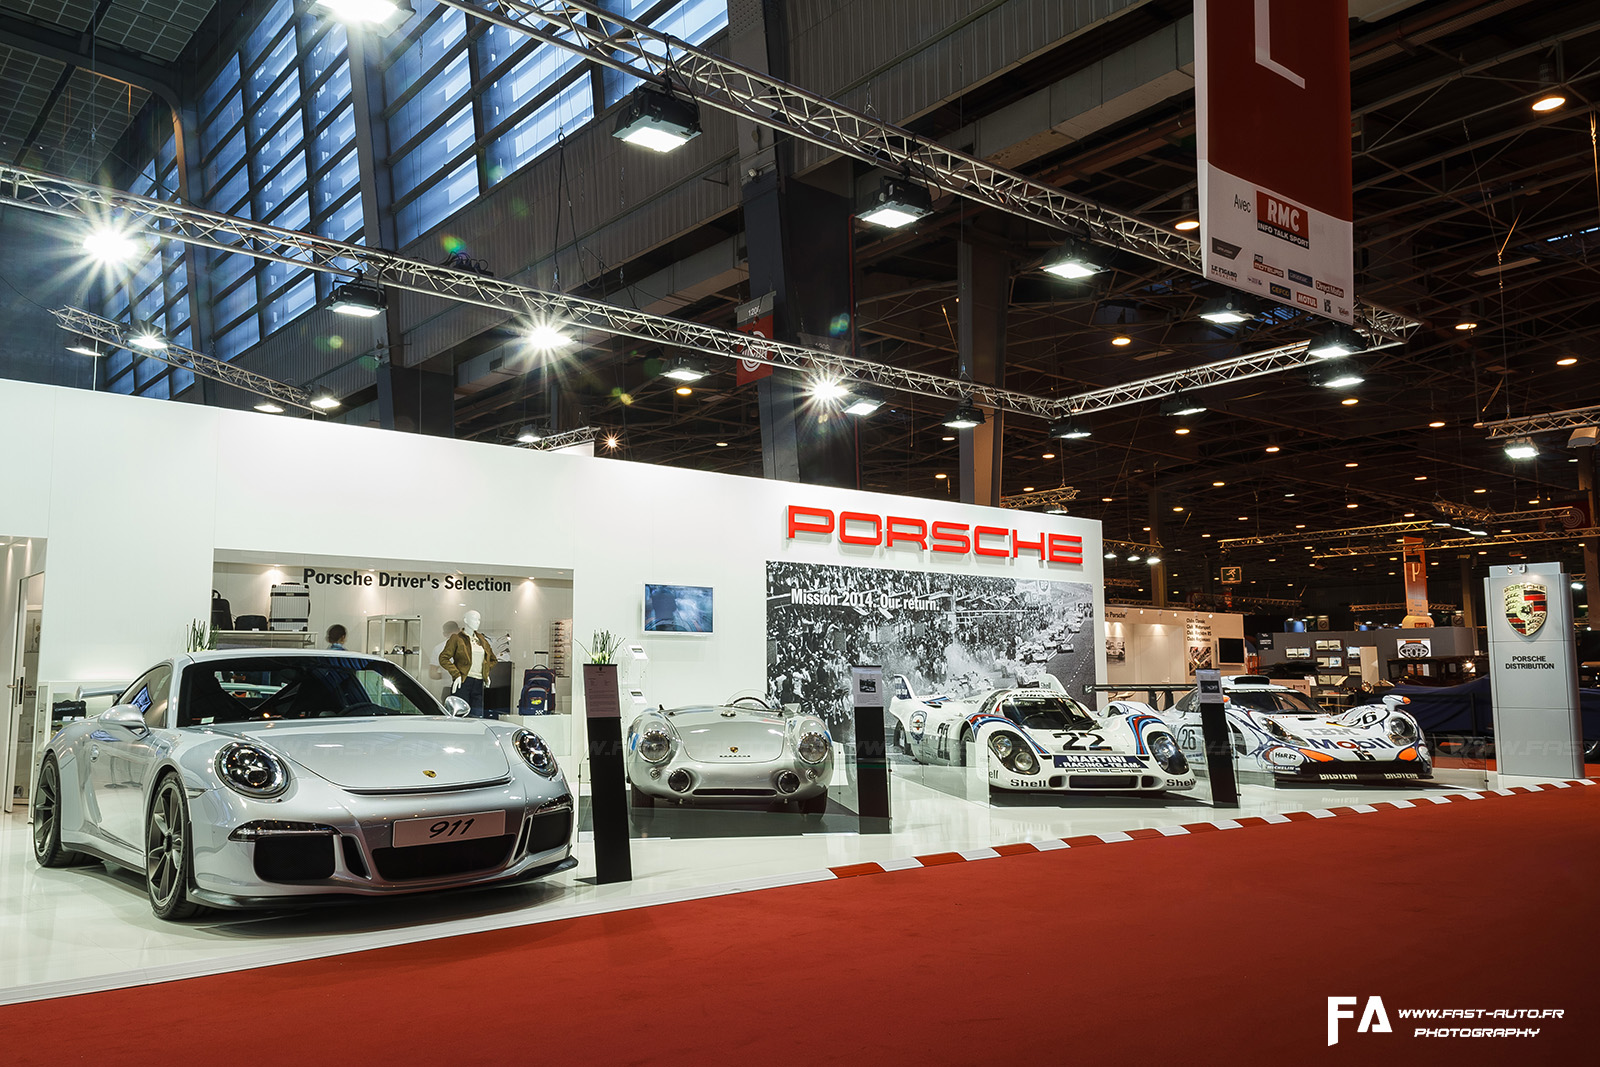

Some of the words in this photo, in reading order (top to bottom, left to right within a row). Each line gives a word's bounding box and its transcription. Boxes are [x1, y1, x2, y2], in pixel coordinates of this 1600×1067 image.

[1233, 194, 1251, 213] Avec
[1268, 199, 1300, 232] RMC
[1257, 222, 1273, 233] INFO
[1274, 228, 1289, 240] TALK
[1289, 234, 1309, 247] SPORT
[1211, 264, 1218, 272] LE
[1218, 266, 1238, 278] FIGARO
[1211, 270, 1238, 282] MAGAZINE
[1298, 294, 1317, 307] MOTUL
[787, 505, 1083, 564] PORSCHE
[303, 568, 373, 586] Porsche
[379, 572, 440, 589] Driver's
[444, 575, 512, 592] Selection
[1503, 583, 1546, 593] PORSCHE
[791, 588, 838, 606] Mission
[842, 591, 877, 608] 2014.
[879, 593, 903, 609] Our
[903, 598, 940, 611] return.
[1052, 732, 1114, 751] 22
[1181, 729, 1197, 750] 26
[1306, 738, 1395, 749] Mobil
[1010, 779, 1046, 787] Shell
[429, 818, 475, 838] 911
